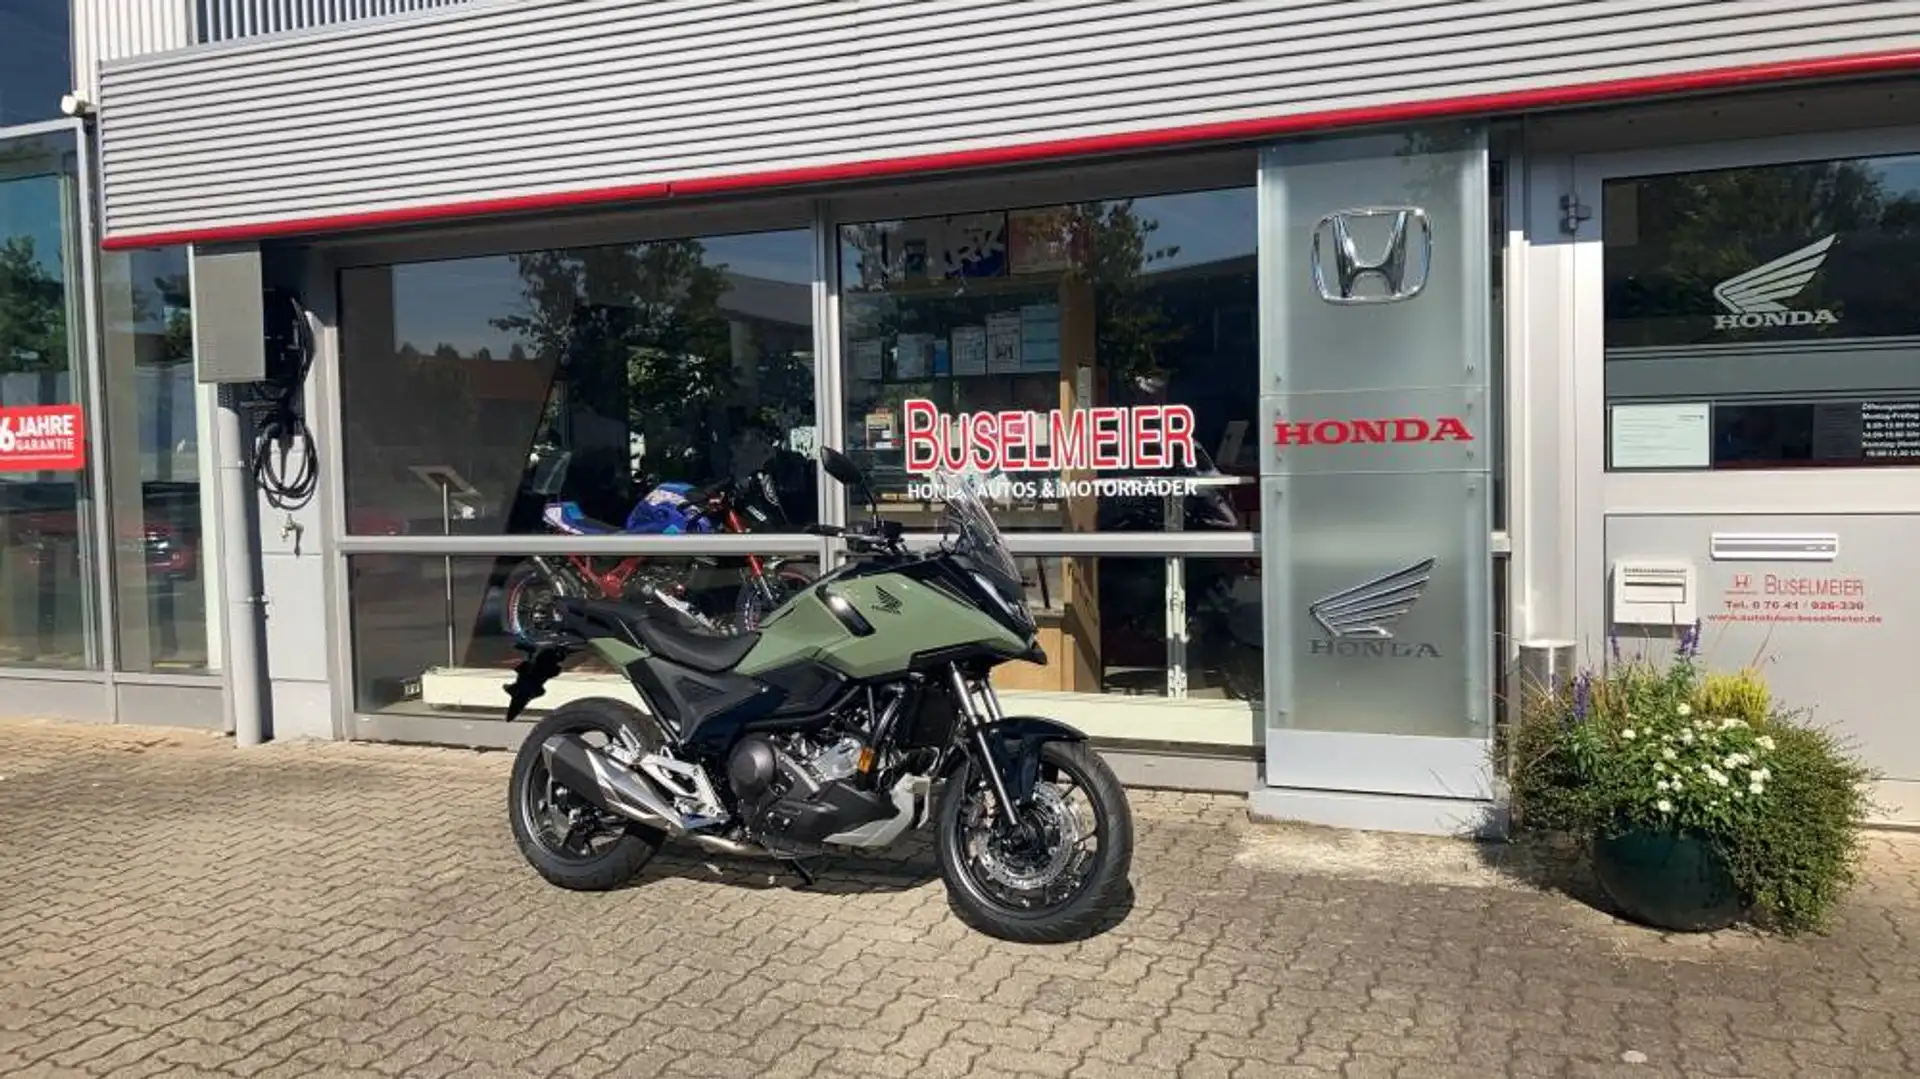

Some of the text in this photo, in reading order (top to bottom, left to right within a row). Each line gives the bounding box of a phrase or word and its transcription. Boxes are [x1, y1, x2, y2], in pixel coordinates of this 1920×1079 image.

[1713, 309, 1839, 330] HONDA
[15, 414, 75, 437] JAHRE
[904, 398, 1197, 473] BUSELMEIER
[1273, 417, 1475, 445] HONDA
[15, 437, 75, 452] GARANTIE
[976, 481, 1037, 498] AUTOS
[1042, 480, 1057, 498] &
[1764, 574, 1864, 597] BUSELMEIER
[1725, 600, 1748, 610] Tel.
[1307, 640, 1443, 658] HONDA
